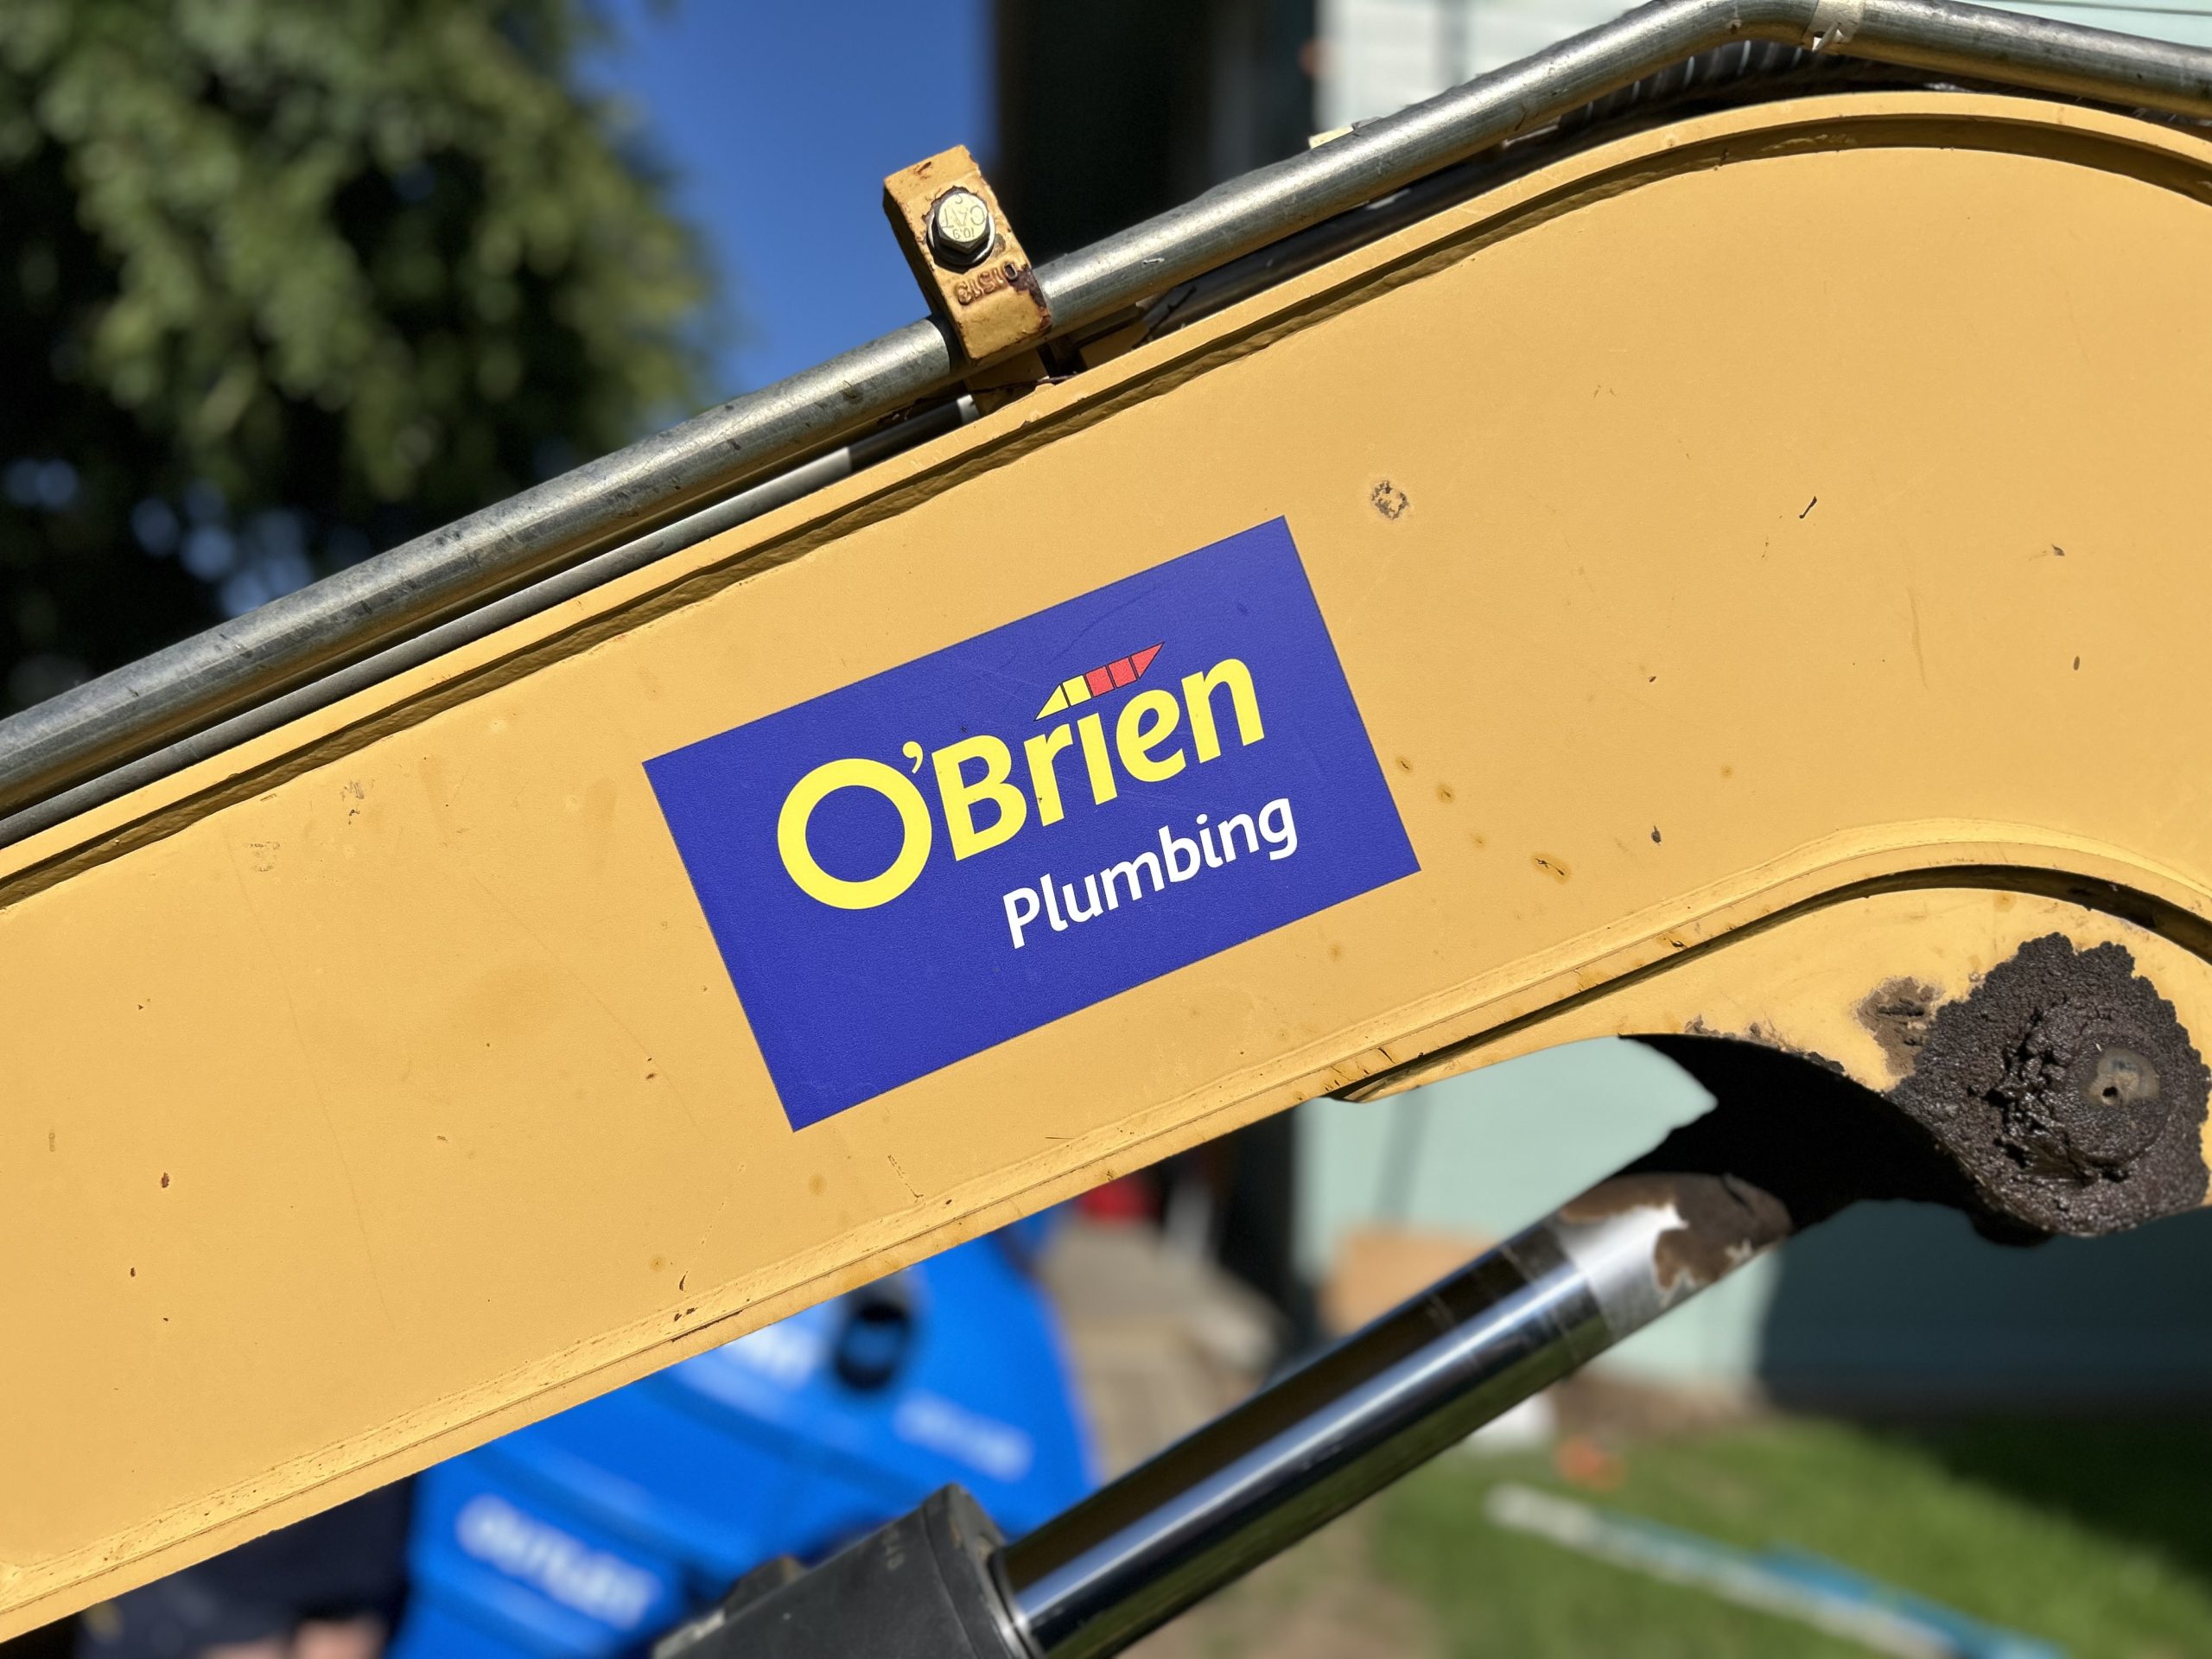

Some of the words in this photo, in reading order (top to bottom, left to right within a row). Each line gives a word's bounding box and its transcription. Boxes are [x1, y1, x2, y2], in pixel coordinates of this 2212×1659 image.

[941, 204, 985, 229] CAT
[952, 226, 975, 239] 10.9
[778, 658, 1263, 910] O'Brien
[1002, 797, 1298, 949] Plumbing
